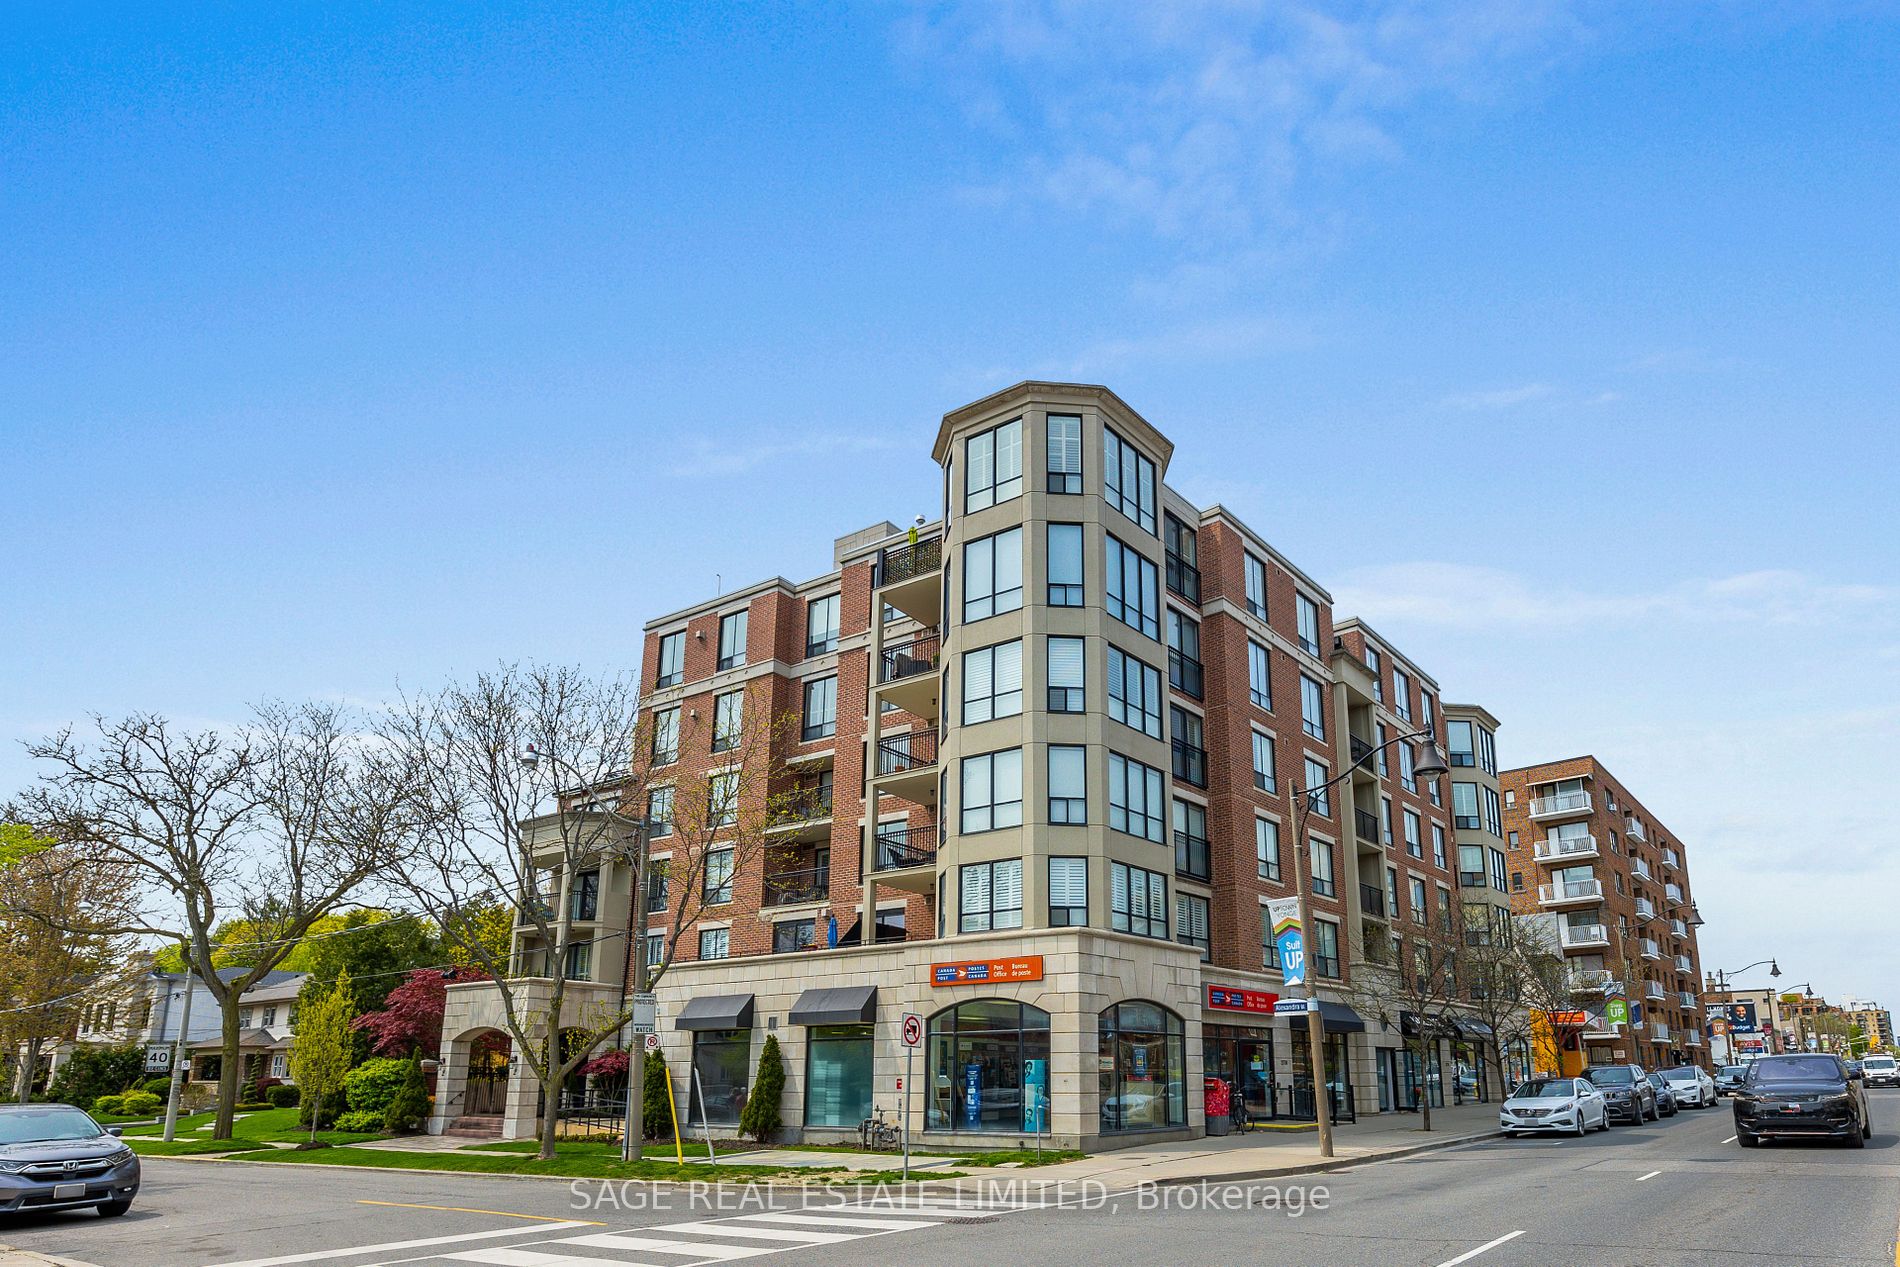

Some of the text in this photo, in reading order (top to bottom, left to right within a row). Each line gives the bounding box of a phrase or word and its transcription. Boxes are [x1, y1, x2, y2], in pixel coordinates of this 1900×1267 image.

[1285, 941, 1300, 950] Suit
[1285, 951, 1303, 969] UP
[1610, 1008, 1624, 1017] UP
[149, 1052, 168, 1063] 40
